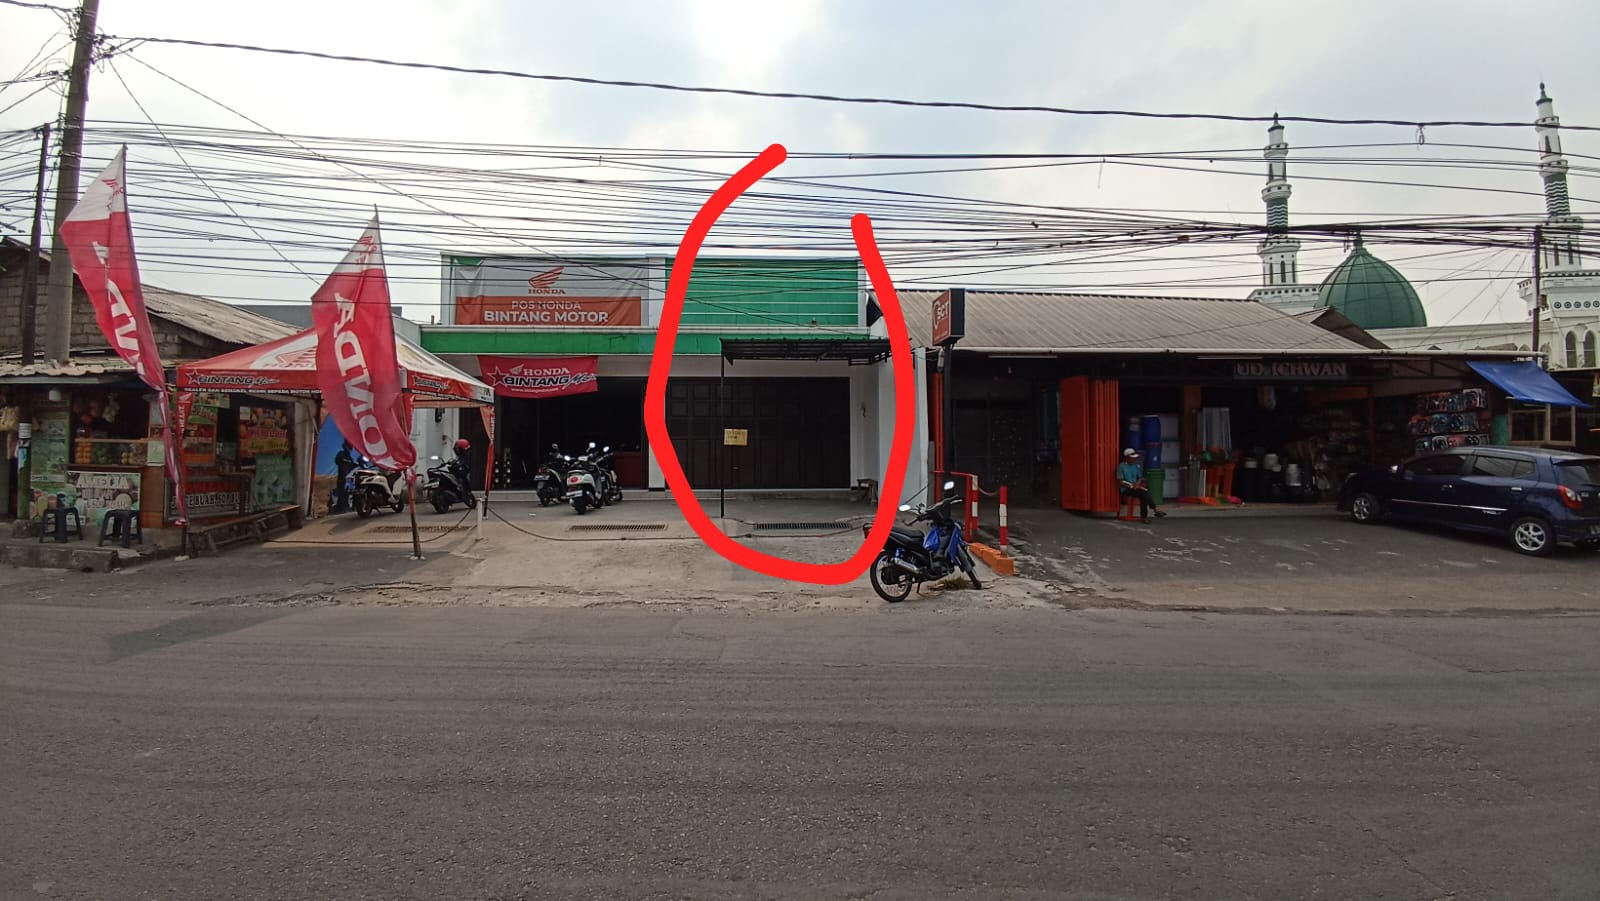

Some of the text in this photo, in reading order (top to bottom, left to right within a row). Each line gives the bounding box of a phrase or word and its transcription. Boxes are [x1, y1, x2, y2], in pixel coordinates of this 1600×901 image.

[511, 300, 582, 310] POS HONDA
[483, 310, 609, 323] BINTANG MOTOR
[523, 367, 570, 376] HONDA
[1271, 361, 1346, 377] ICHWAN
[198, 375, 254, 385] BINTANG
[503, 375, 570, 388] BINTANG
